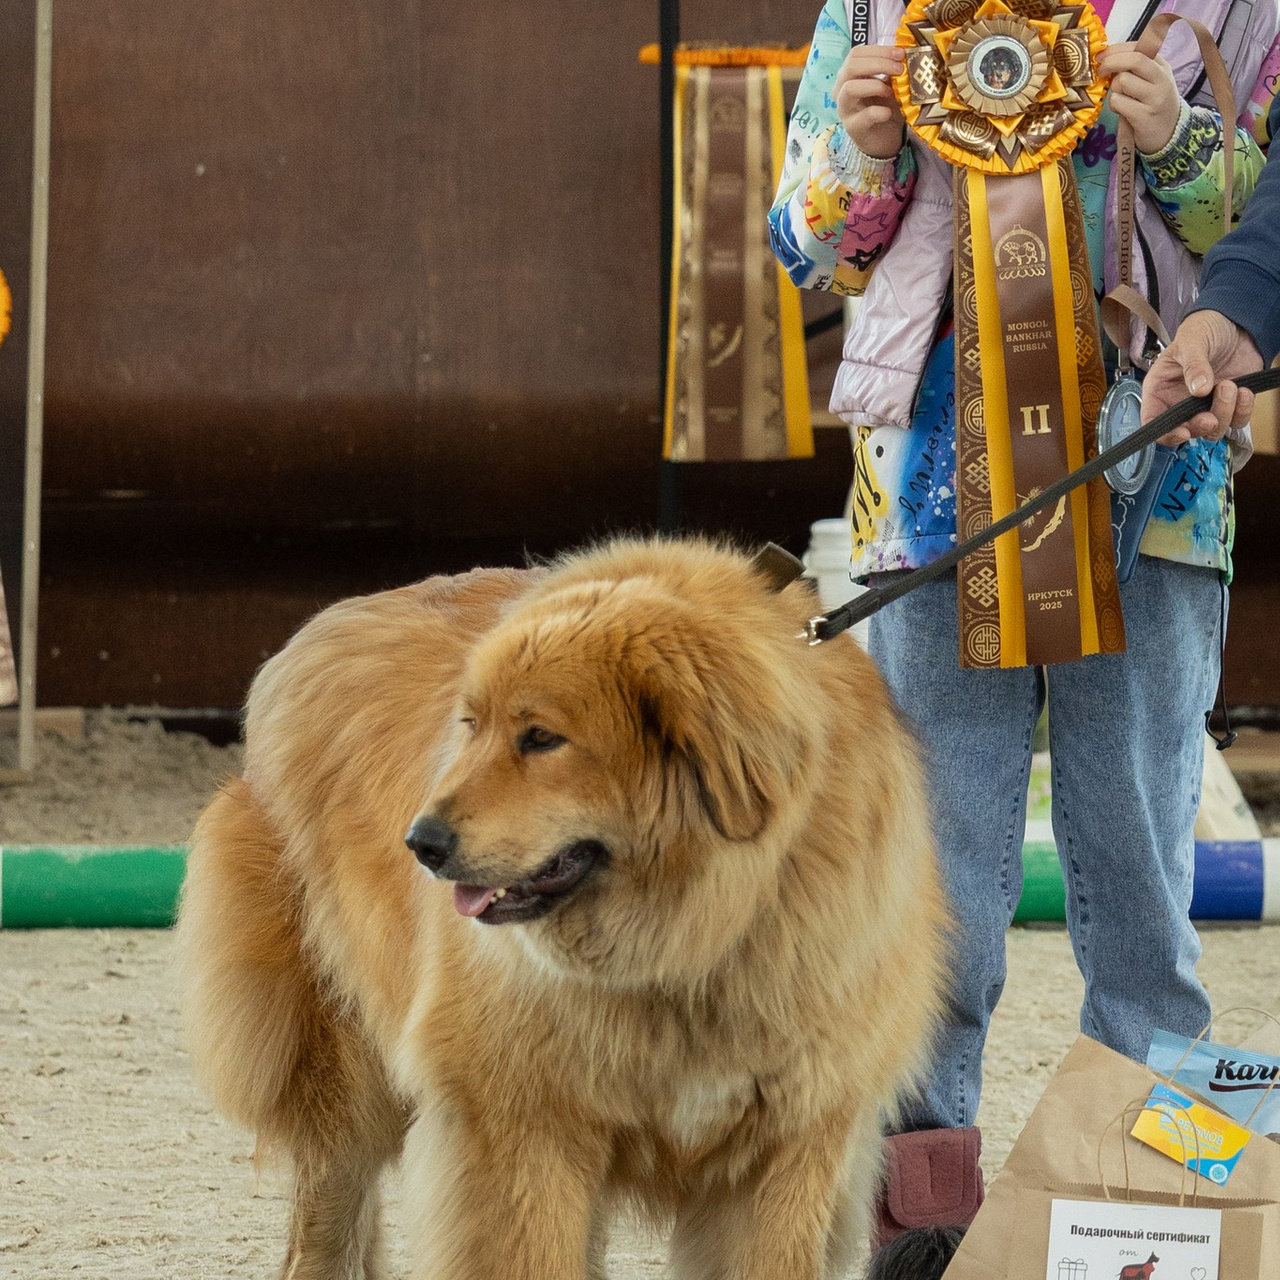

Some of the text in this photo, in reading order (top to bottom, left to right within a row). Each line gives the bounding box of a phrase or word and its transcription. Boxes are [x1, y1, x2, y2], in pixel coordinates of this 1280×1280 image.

[1121, 146, 1132, 211] БАНХАР
[1007, 321, 1049, 331] MONGOL
[1005, 331, 1053, 343] BANKHAR
[1012, 342, 1048, 353] RUSSIA
[1020, 404, 1052, 436] II
[1027, 589, 1074, 601] ИРКУТСК
[1039, 600, 1063, 611] 2025
[1070, 1224, 1211, 1244] Подарочный сертификат
[1118, 1248, 1139, 1257] от
